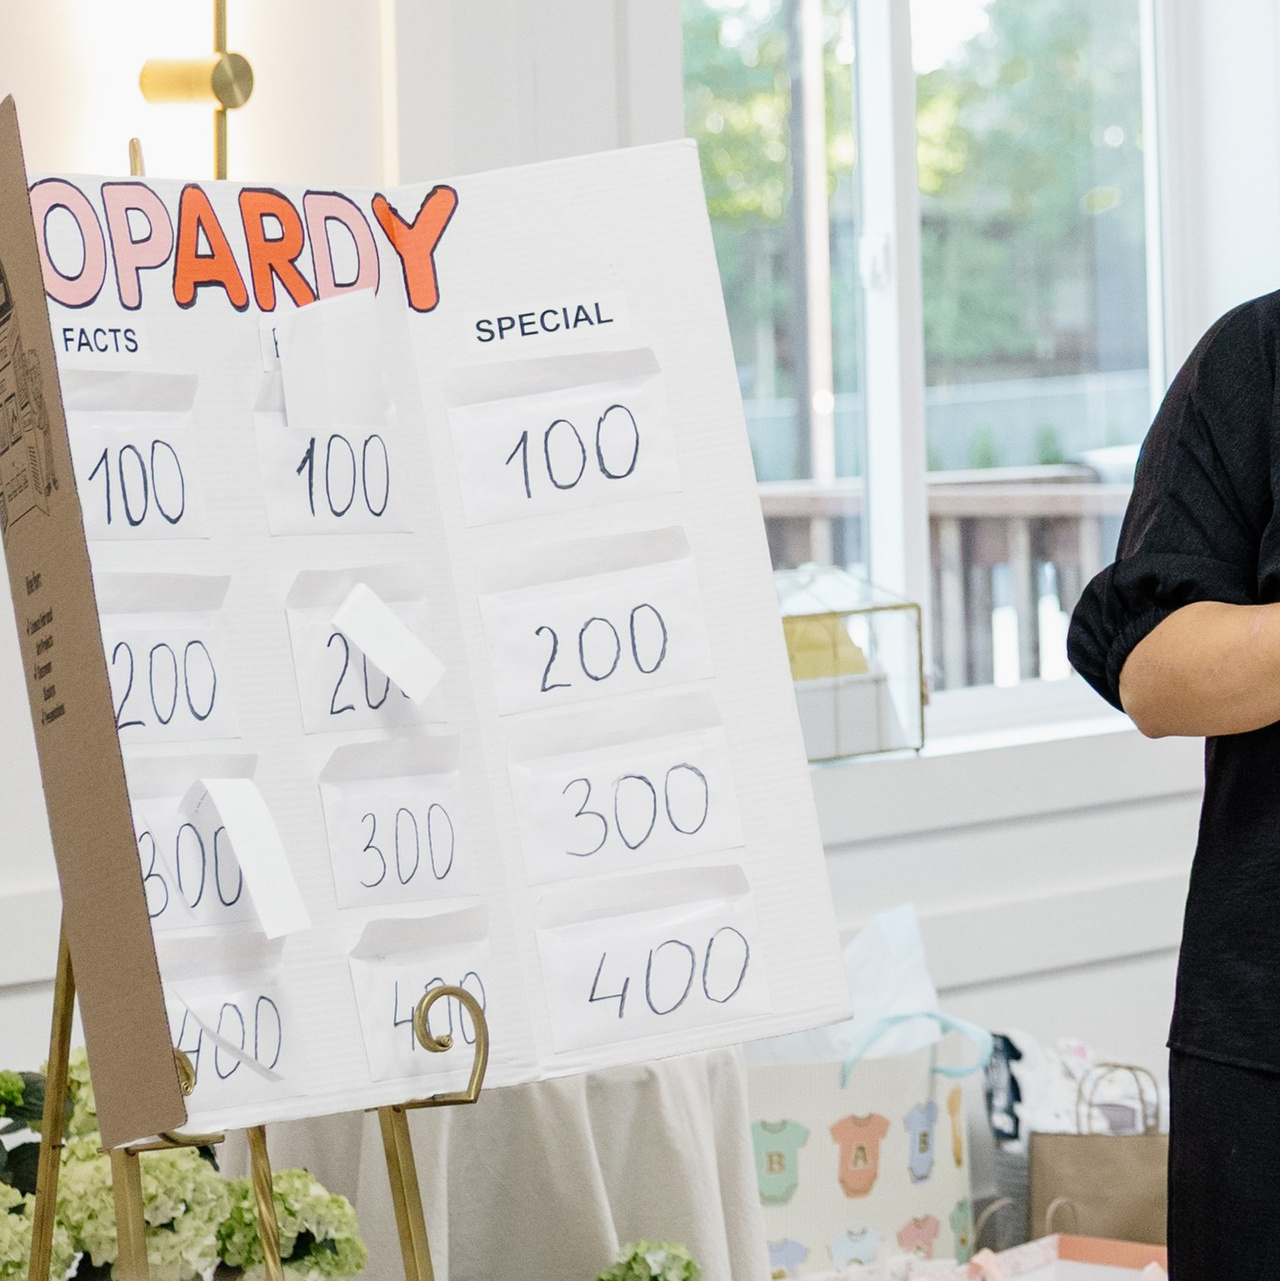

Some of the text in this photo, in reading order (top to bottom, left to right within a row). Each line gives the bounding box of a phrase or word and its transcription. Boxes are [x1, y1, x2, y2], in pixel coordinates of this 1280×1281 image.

[28, 177, 459, 313] OPARDY
[62, 327, 139, 353] FACTS
[475, 302, 614, 343] SPECIAL
[87, 439, 185, 526] 100
[295, 433, 390, 518] 100
[505, 404, 640, 499] 100
[112, 639, 217, 730] 200
[326, 632, 410, 715] 20
[534, 603, 668, 693] 200
[361, 803, 454, 888] 300
[562, 763, 708, 857] 300
[139, 822, 243, 918] 300
[588, 926, 749, 1019] 400
[176, 995, 282, 1086] 400
[766, 1149, 787, 1175] B
[853, 1143, 869, 1167] A
